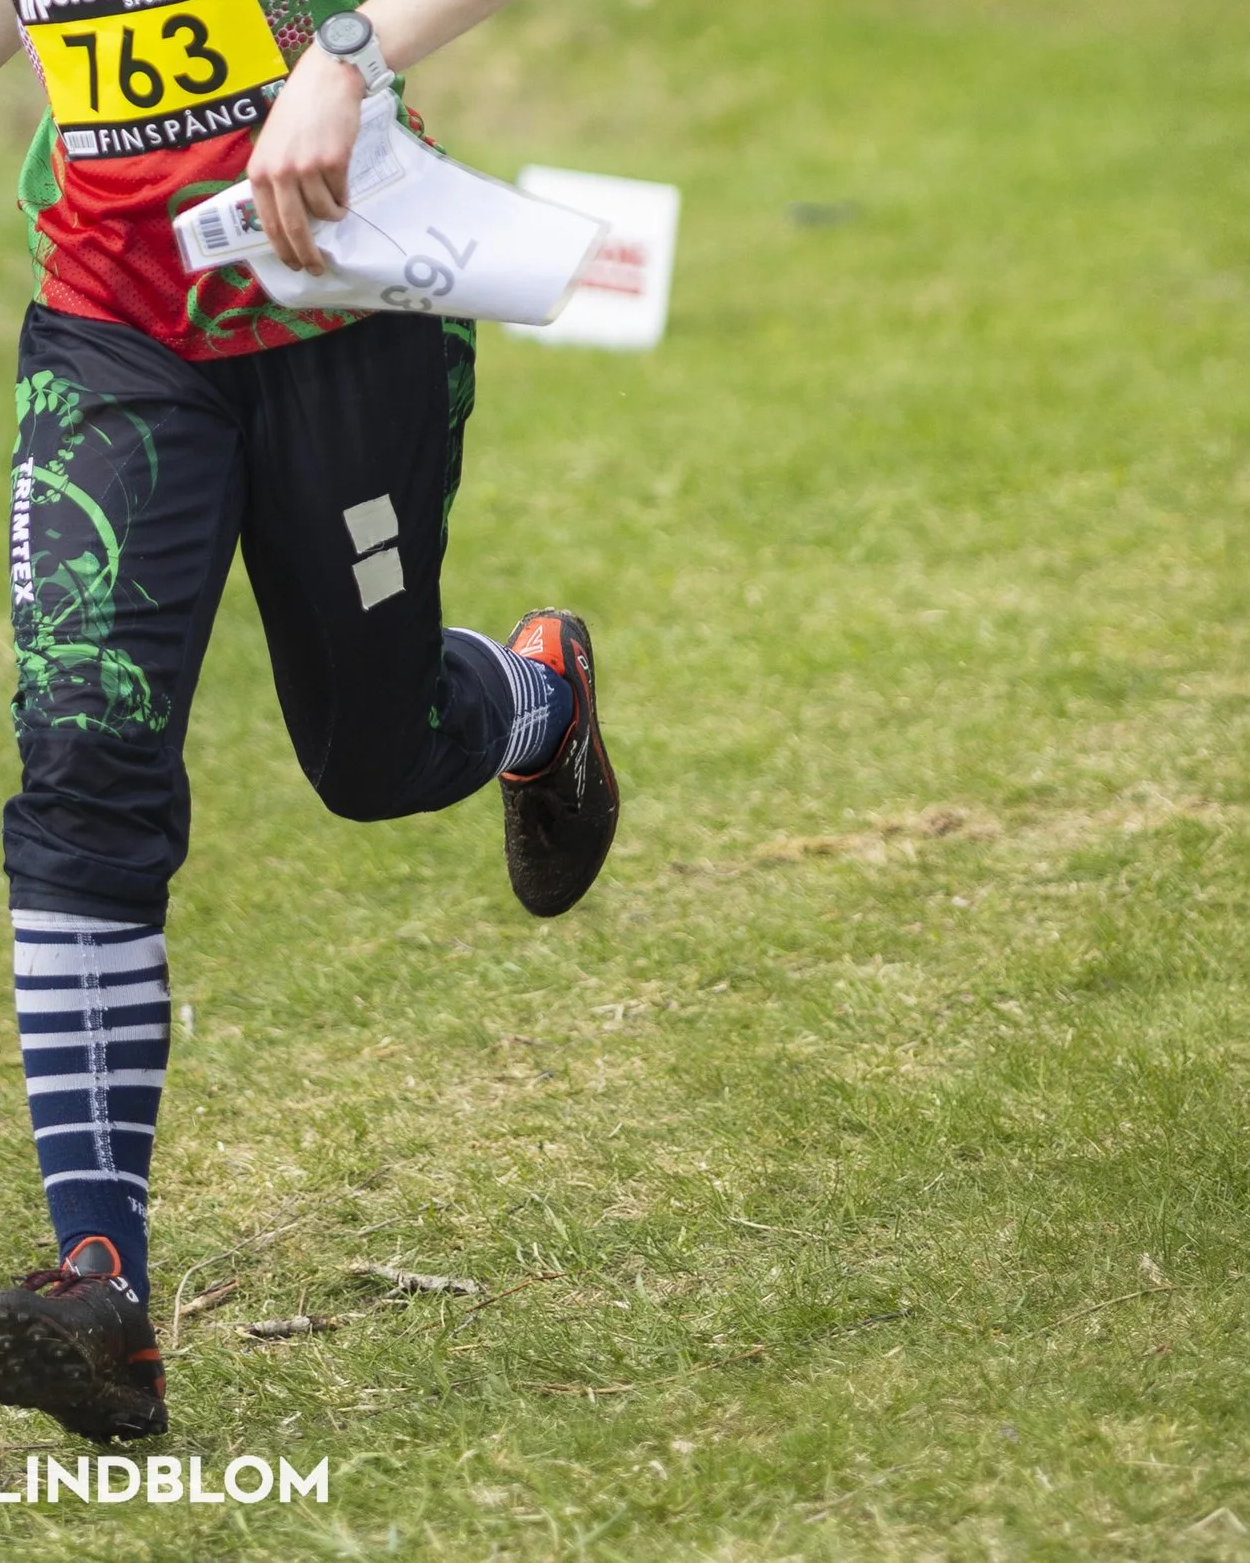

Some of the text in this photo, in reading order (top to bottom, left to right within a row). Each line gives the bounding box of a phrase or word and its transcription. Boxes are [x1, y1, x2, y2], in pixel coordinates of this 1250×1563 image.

[61, 13, 229, 113] 763
[99, 98, 258, 154] FINSPÅNG
[379, 225, 479, 313] 763
[12, 456, 35, 606] TRIMTEX
